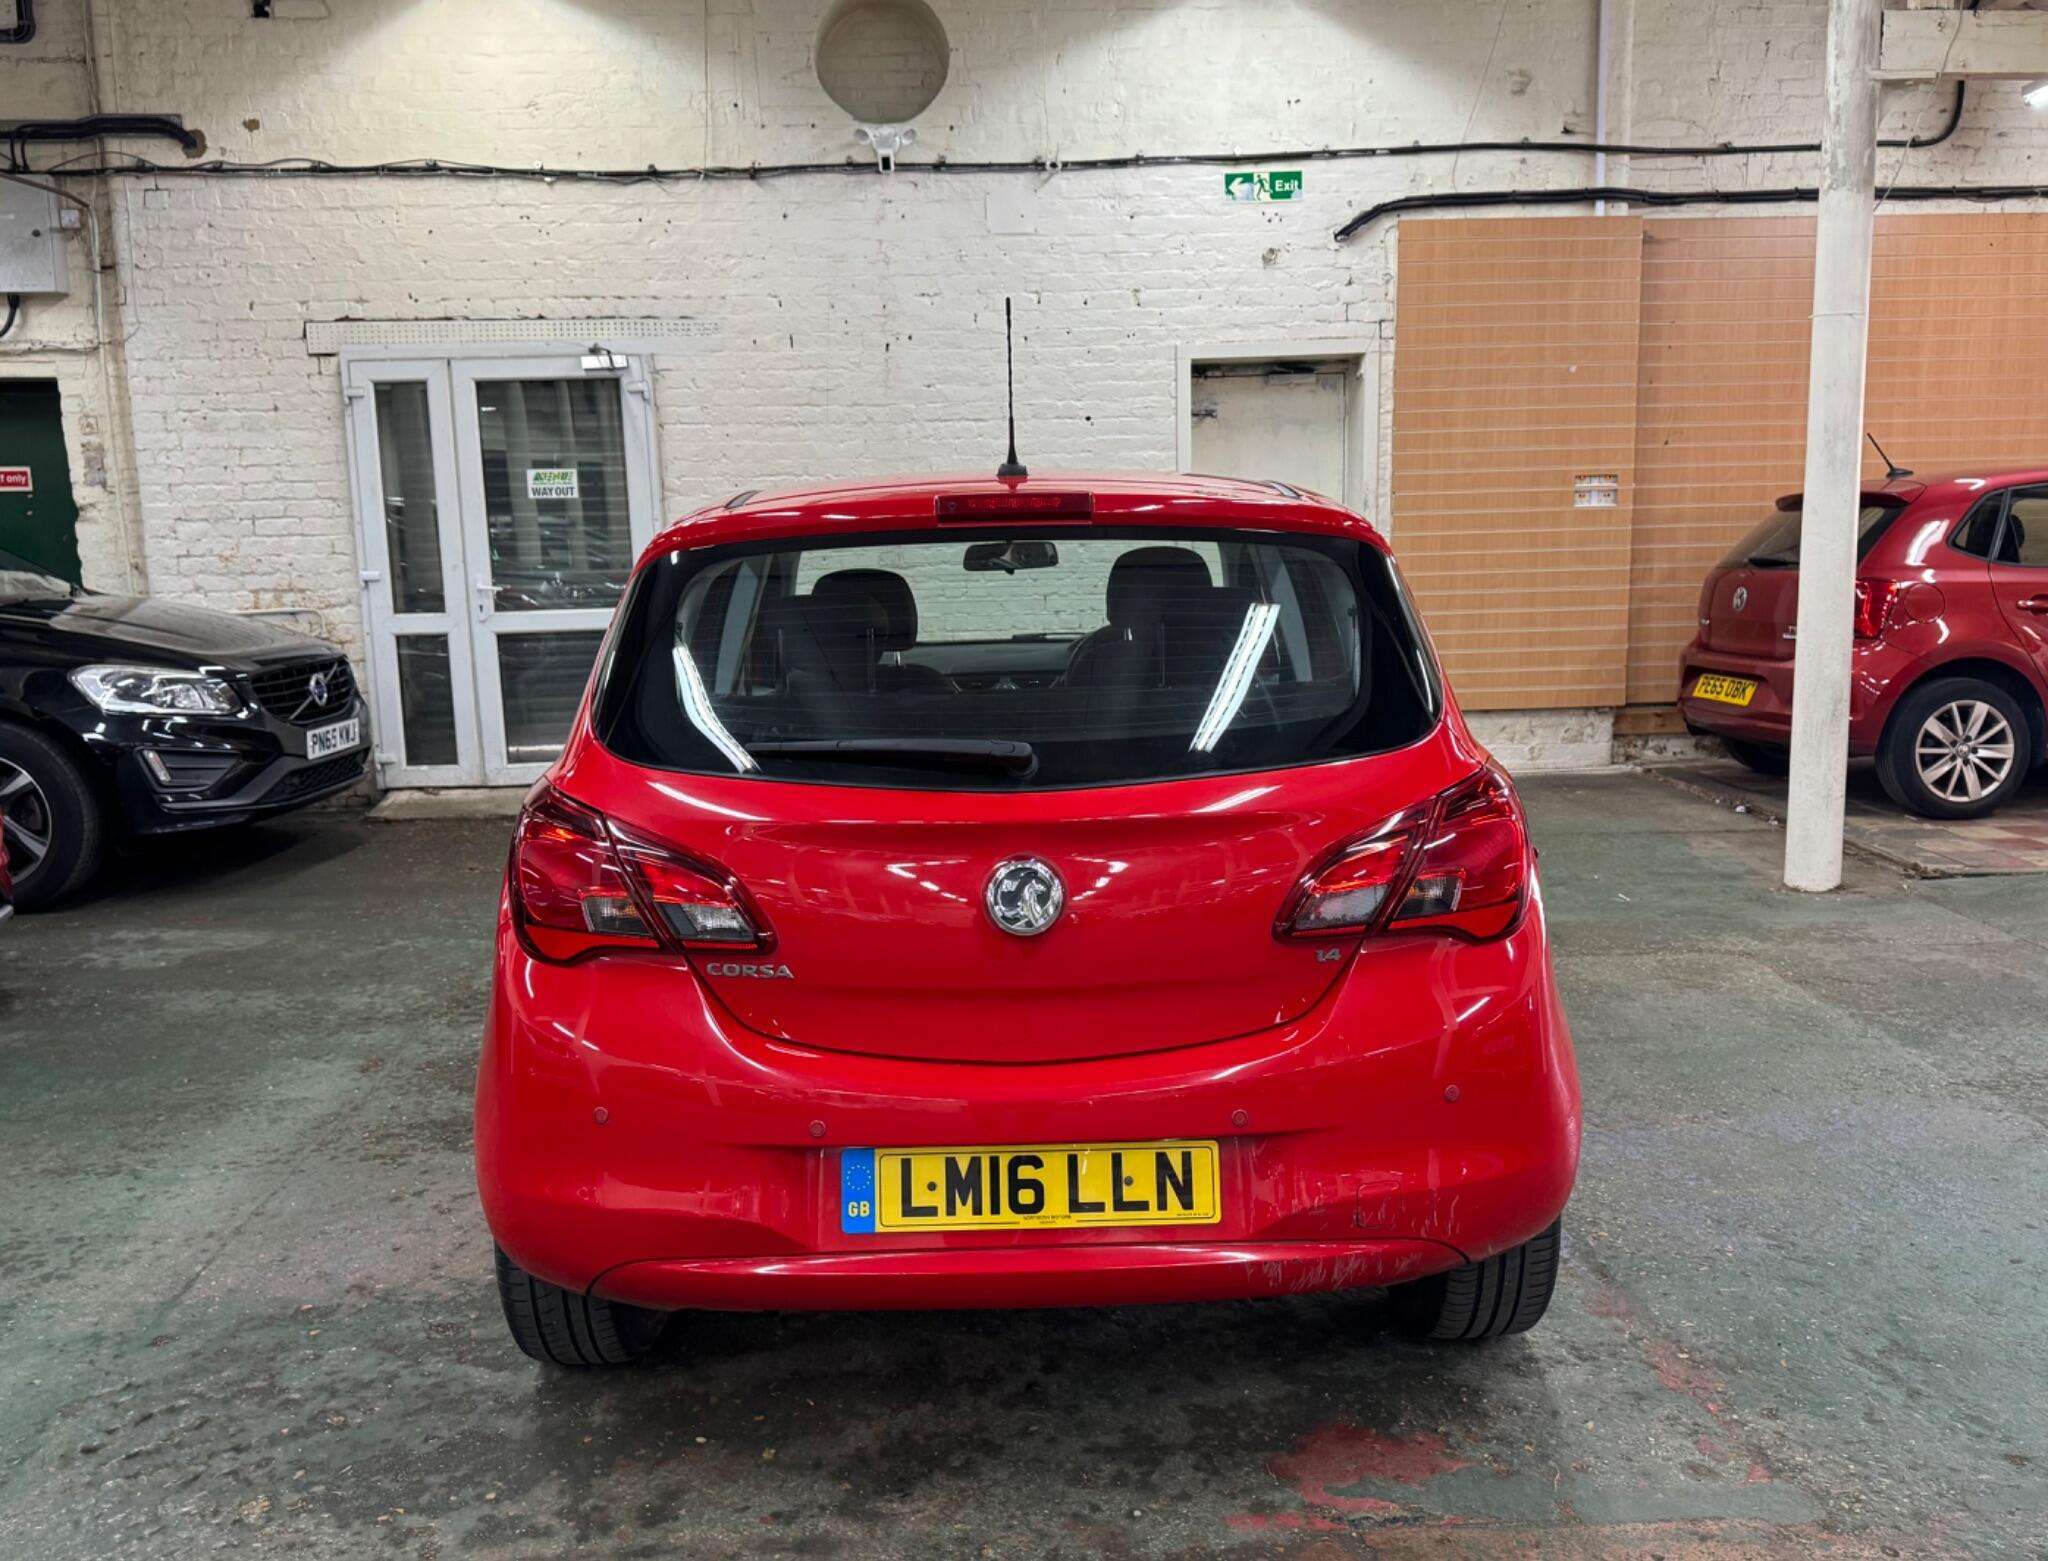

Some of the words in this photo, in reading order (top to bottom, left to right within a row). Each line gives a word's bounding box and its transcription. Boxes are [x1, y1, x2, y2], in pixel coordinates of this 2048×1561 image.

[1275, 179, 1299, 192] Exit
[531, 486, 554, 497] WAY
[554, 486, 576, 497] OUT
[311, 728, 337, 755] PN65
[338, 722, 356, 746] KWJ
[706, 962, 795, 979] CORSA
[900, 1154, 1046, 1218] LM16
[1066, 1150, 1195, 1214] LLN
[848, 1201, 870, 1218] GB
